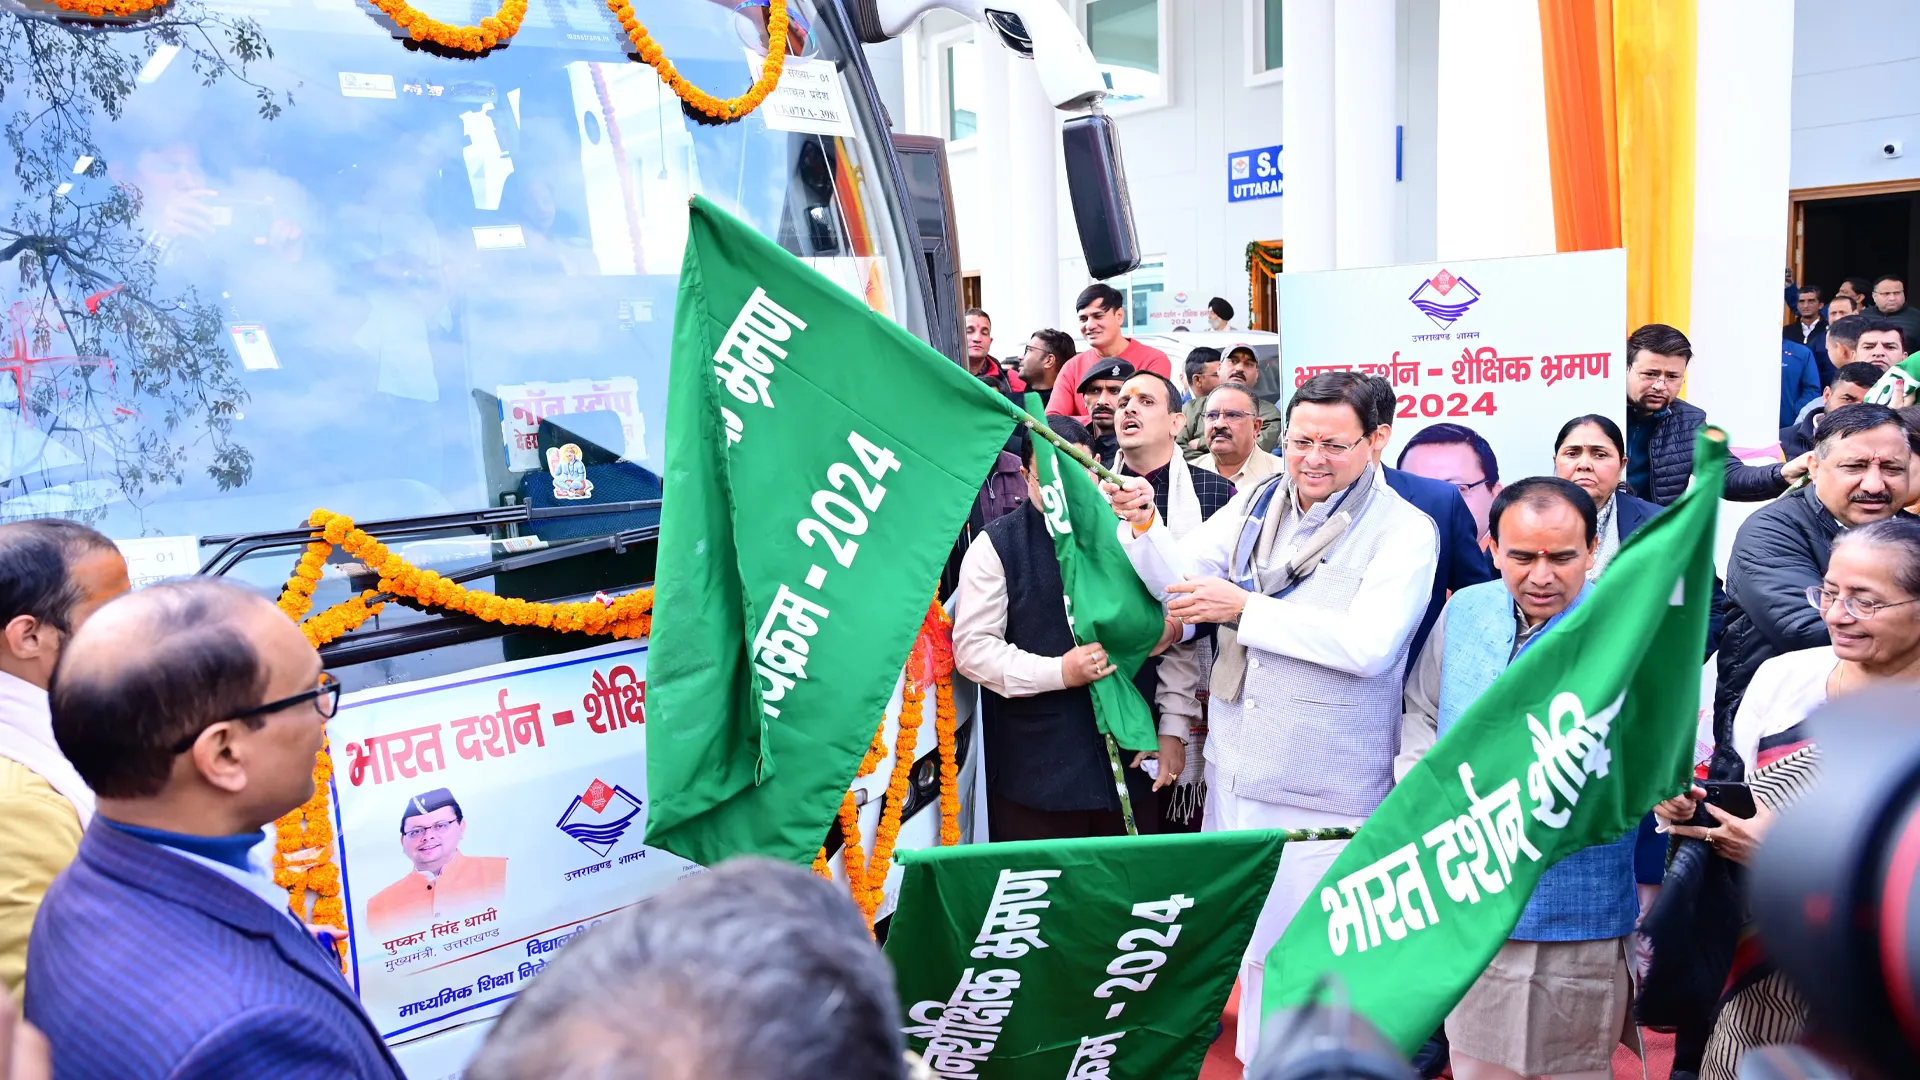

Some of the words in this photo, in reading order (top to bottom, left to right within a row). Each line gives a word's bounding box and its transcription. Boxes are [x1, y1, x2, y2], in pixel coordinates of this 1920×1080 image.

[809, 88, 829, 101] प्रदेश
[820, 74, 830, 83] 01
[1411, 333, 1450, 343] उत्तराखण्ड
[1456, 331, 1480, 340] शासन
[1451, 346, 1533, 385] शैक्षिक
[1541, 351, 1612, 387] भ्रमण
[1396, 391, 1497, 419] 2024
[797, 429, 901, 571] 2024
[156, 552, 174, 562] 01
[346, 723, 447, 787] भारत
[450, 688, 546, 762] दर्शन
[564, 860, 612, 882] उत्तराखण्ड
[618, 849, 646, 865] शासन
[1320, 842, 1440, 957] भारत
[1422, 761, 1542, 905] दर्शन
[383, 930, 427, 956] पुष्कर
[431, 919, 460, 938] सिंह
[465, 907, 497, 927] धामी
[969, 868, 1062, 959] भ्रमण
[443, 927, 500, 952] उत्तराखण्ड
[1093, 893, 1195, 999] 2024
[398, 982, 473, 1019] माध्यमिक
[477, 971, 513, 995] शिक्षा
